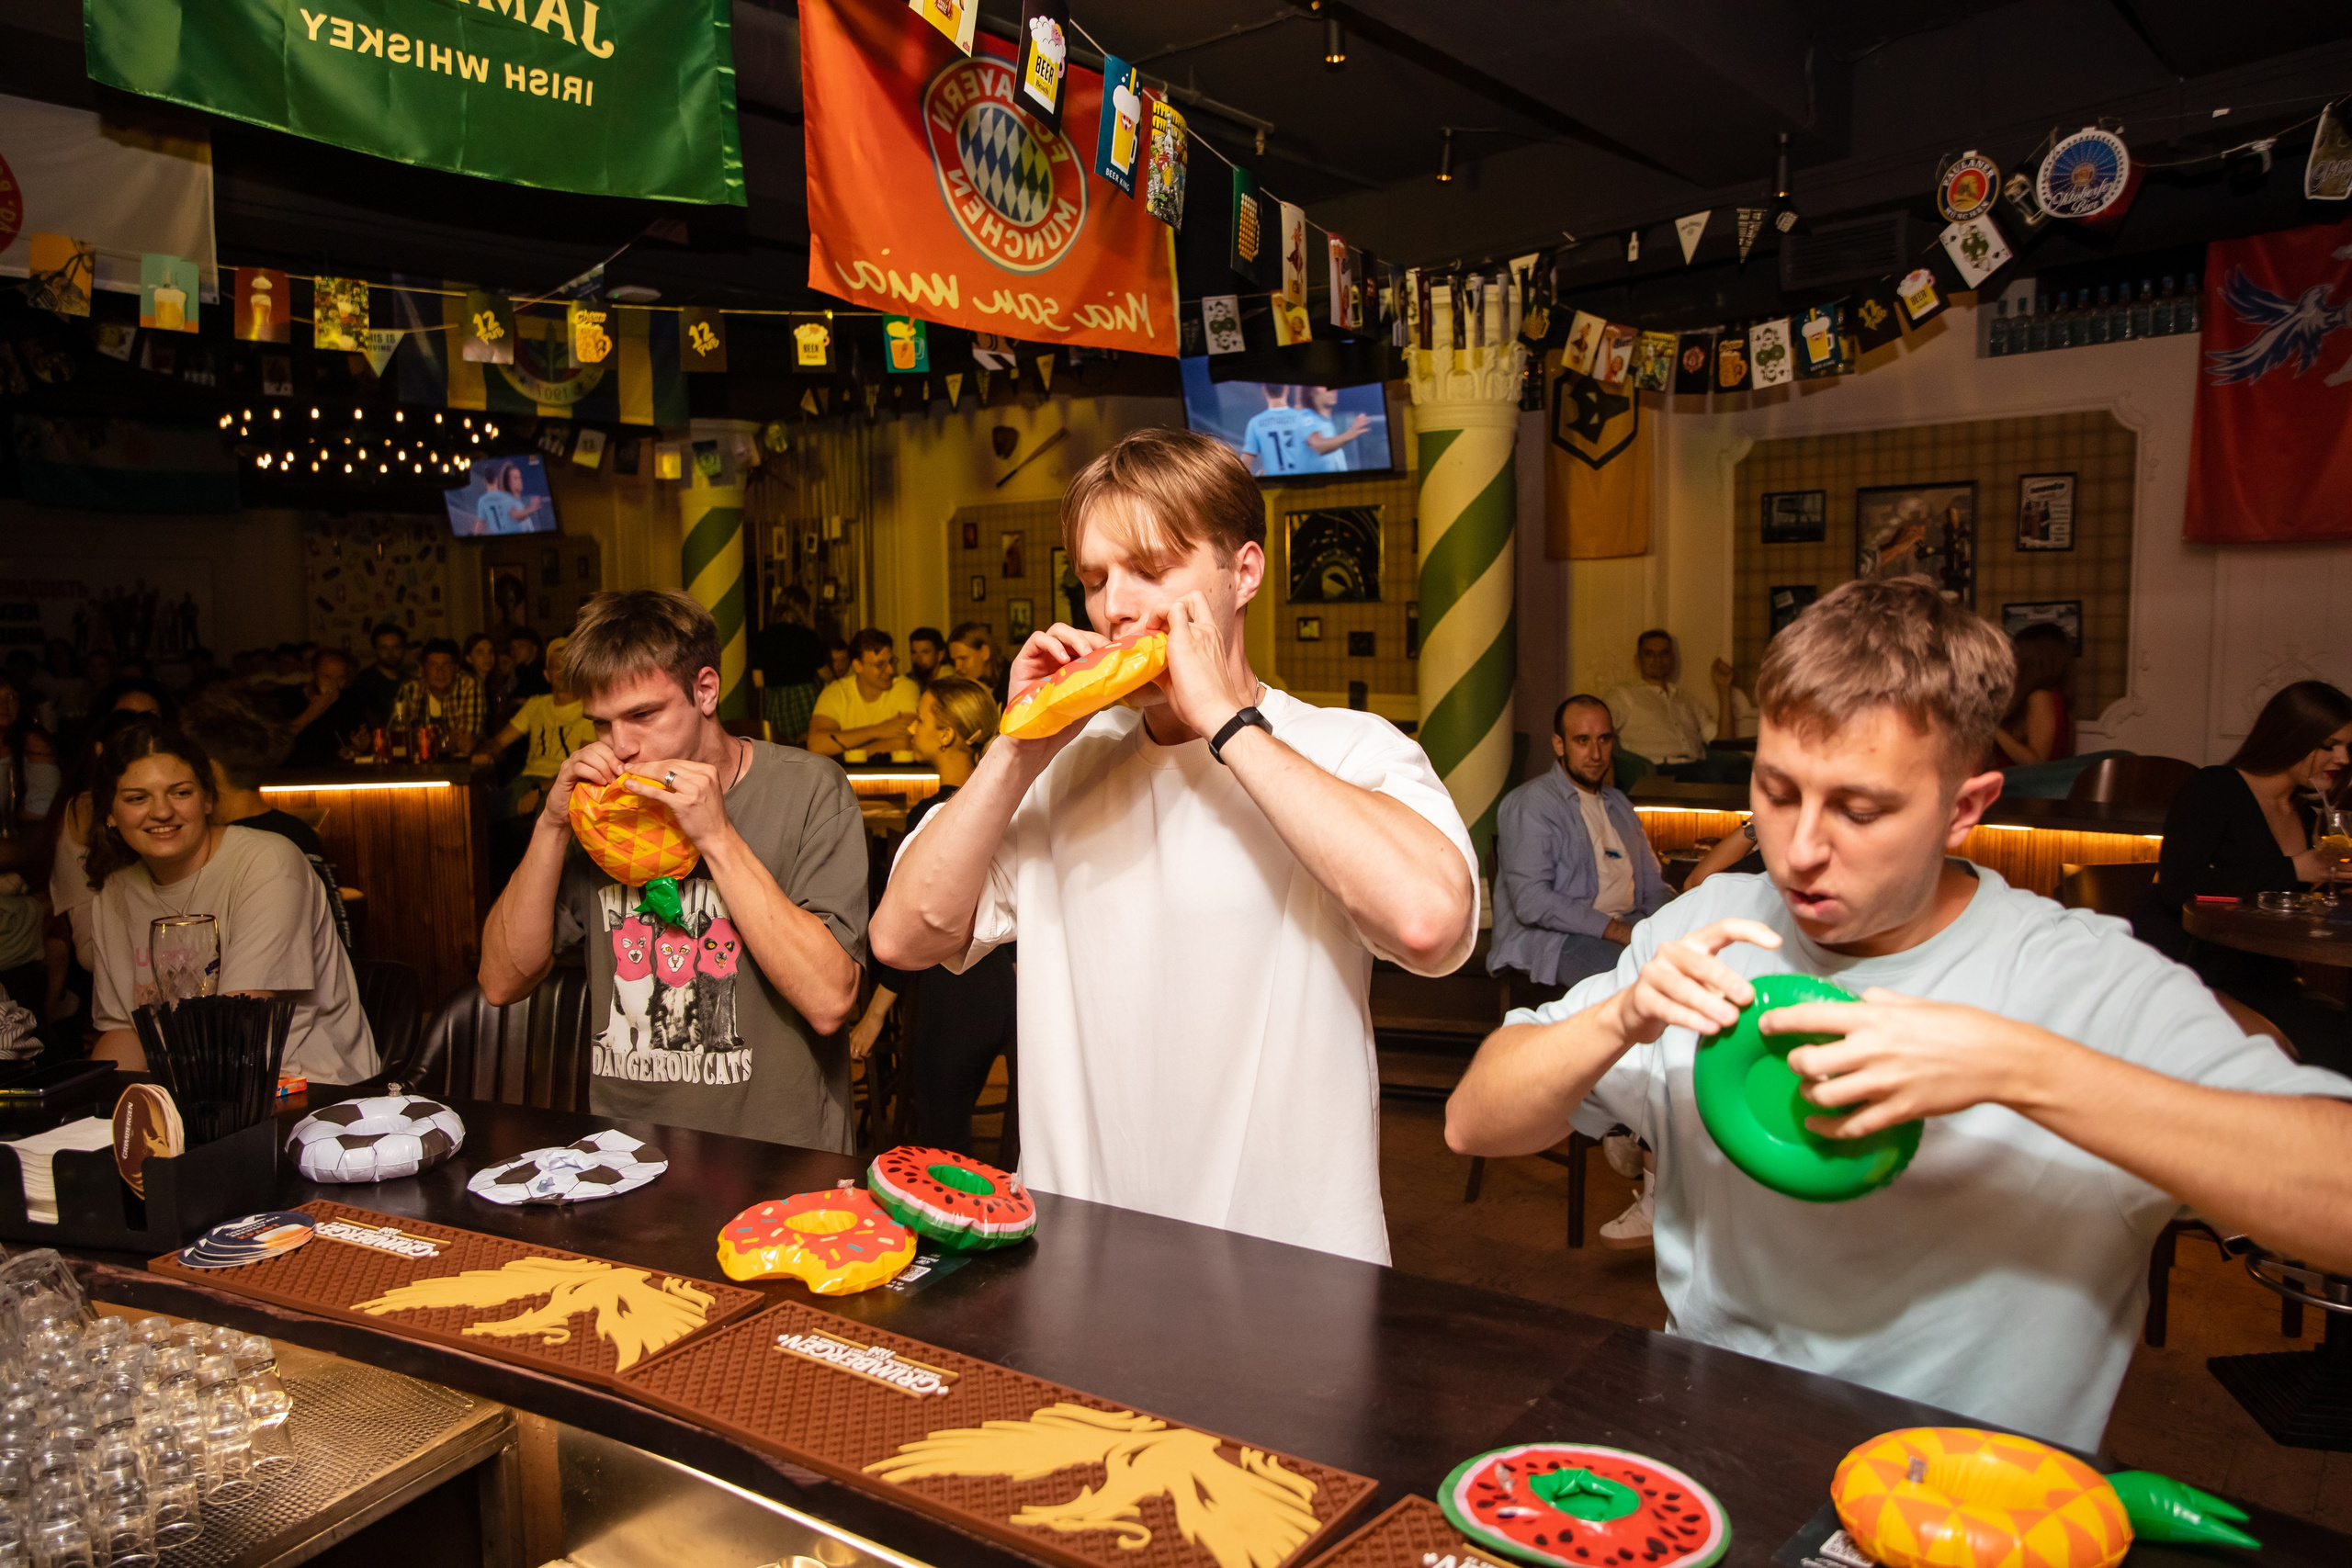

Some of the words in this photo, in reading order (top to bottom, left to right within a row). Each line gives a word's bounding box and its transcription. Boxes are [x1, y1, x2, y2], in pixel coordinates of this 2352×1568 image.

[1035, 55, 1055, 85] BEER
[1105, 167, 1120, 182] BEER
[1119, 176, 1130, 192] KING
[1942, 159, 1995, 186] PAULANER
[1909, 289, 1928, 306] BEER
[473, 310, 499, 337] 12
[481, 327, 505, 344] PUB
[689, 321, 715, 349] 12
[697, 337, 719, 357] PUB
[593, 1044, 705, 1084] DANGEROUS
[703, 1048, 753, 1085] CATS
[122, 1101, 134, 1160] GRIMBERGEN
[780, 1335, 941, 1393] GRIMBERGEN
